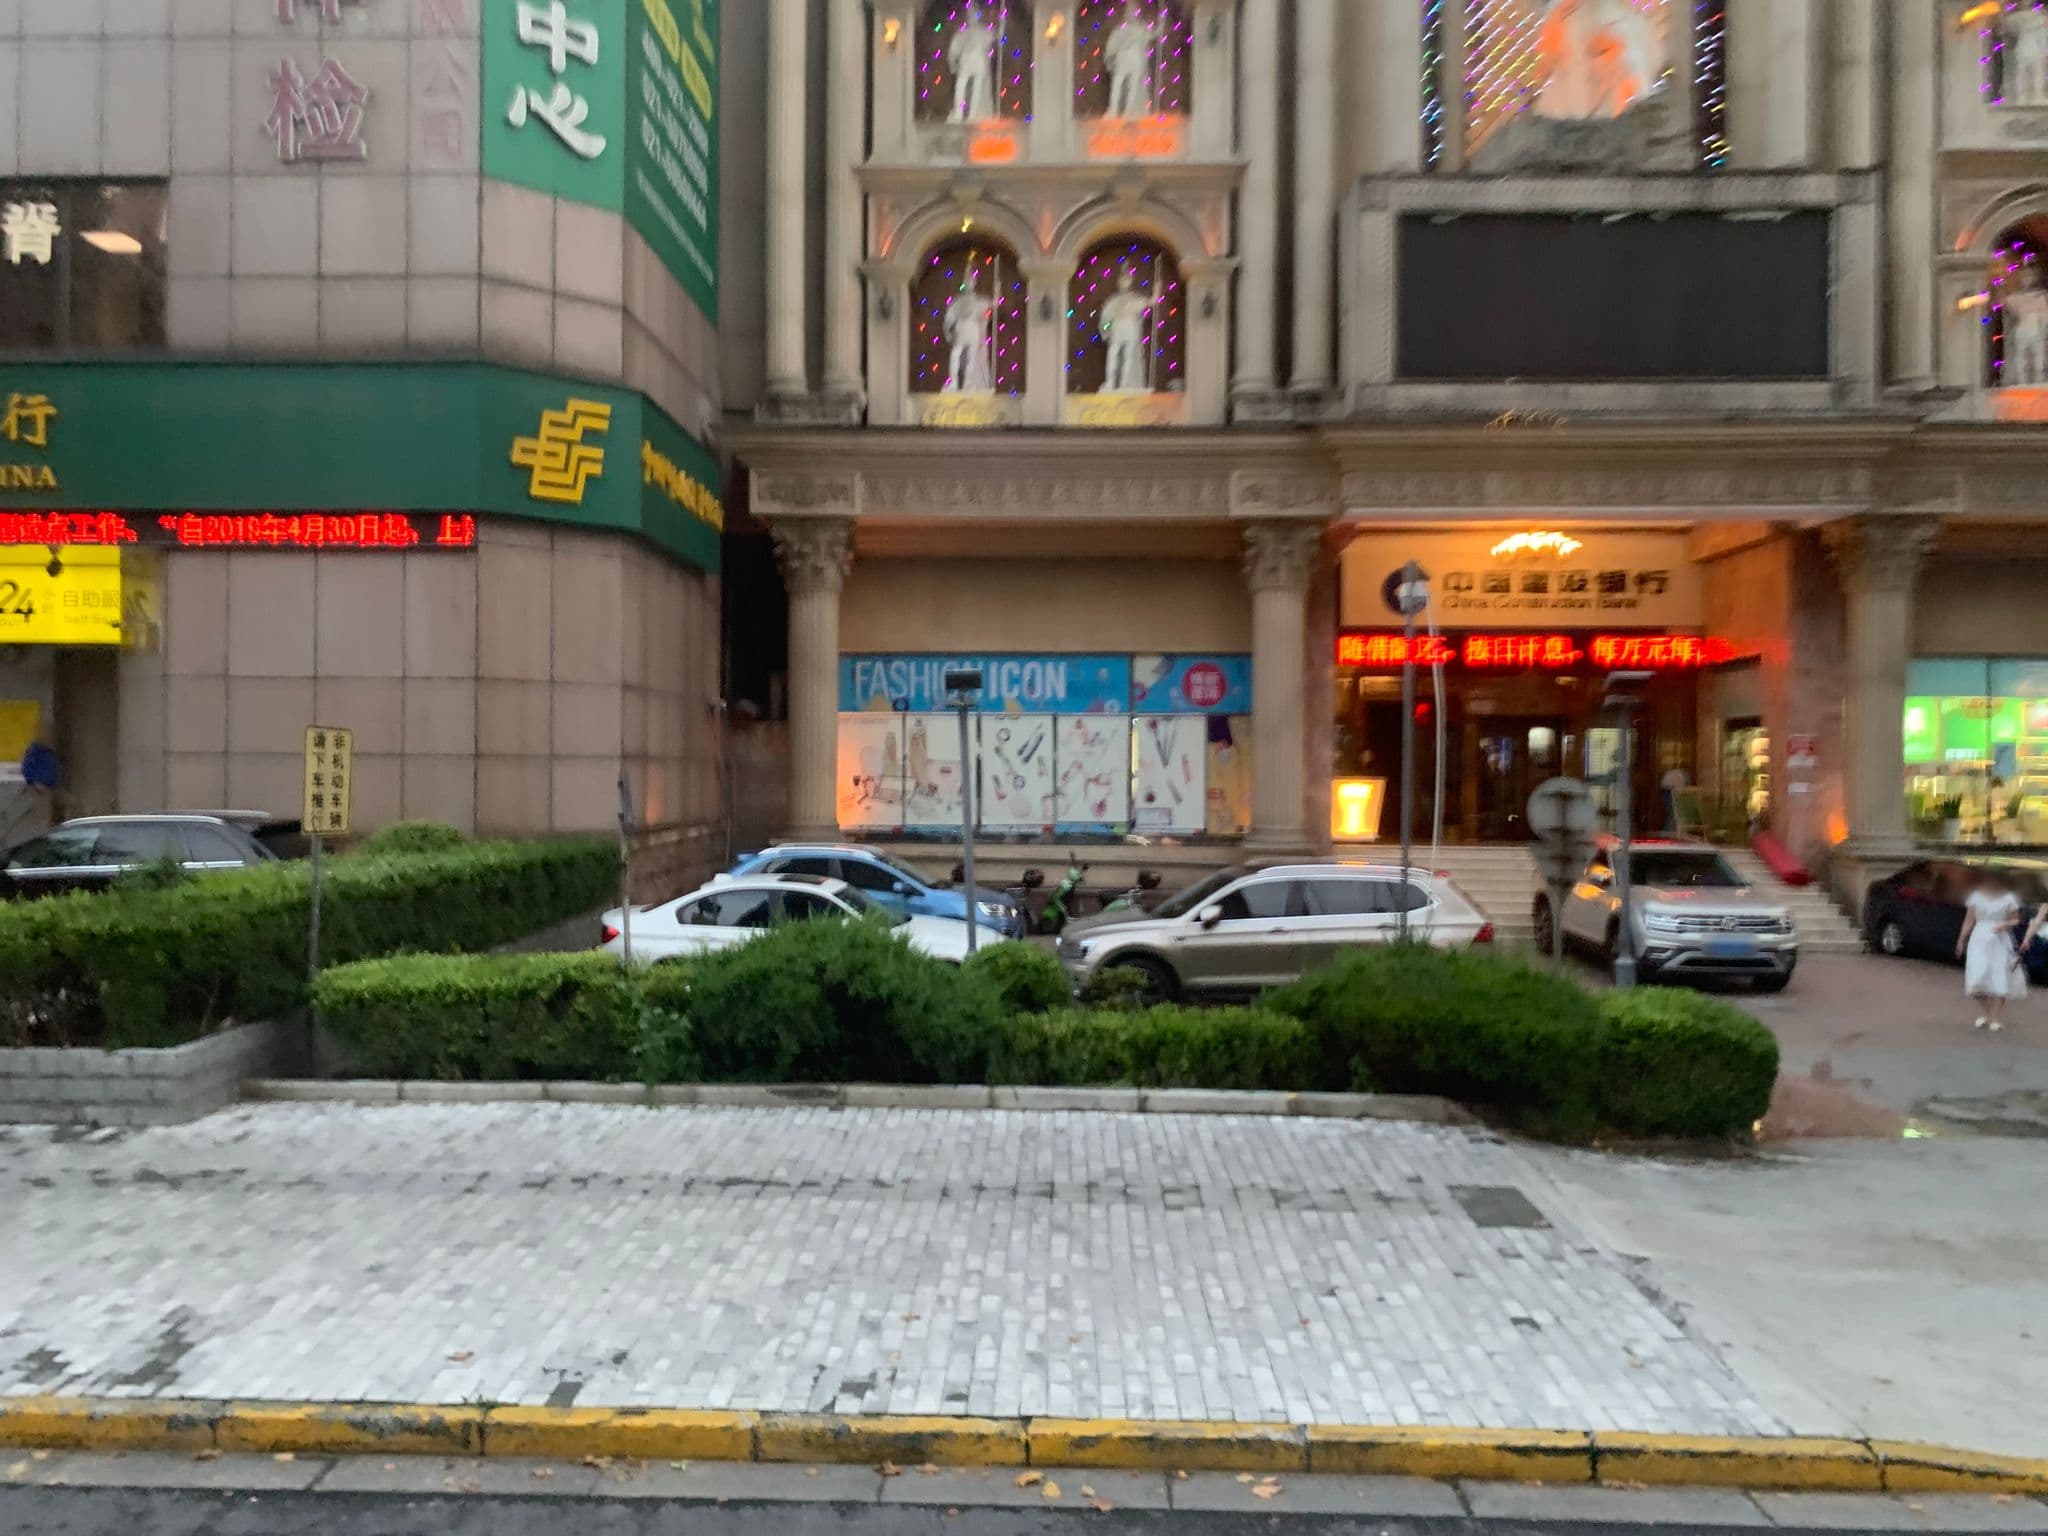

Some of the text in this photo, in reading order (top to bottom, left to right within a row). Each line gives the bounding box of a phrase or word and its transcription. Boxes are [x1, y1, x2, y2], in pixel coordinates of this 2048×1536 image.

[508, 0, 607, 159] 中心
[0, 392, 57, 447] 行
[0, 581, 34, 623] 24
[989, 661, 1067, 701] ICON
